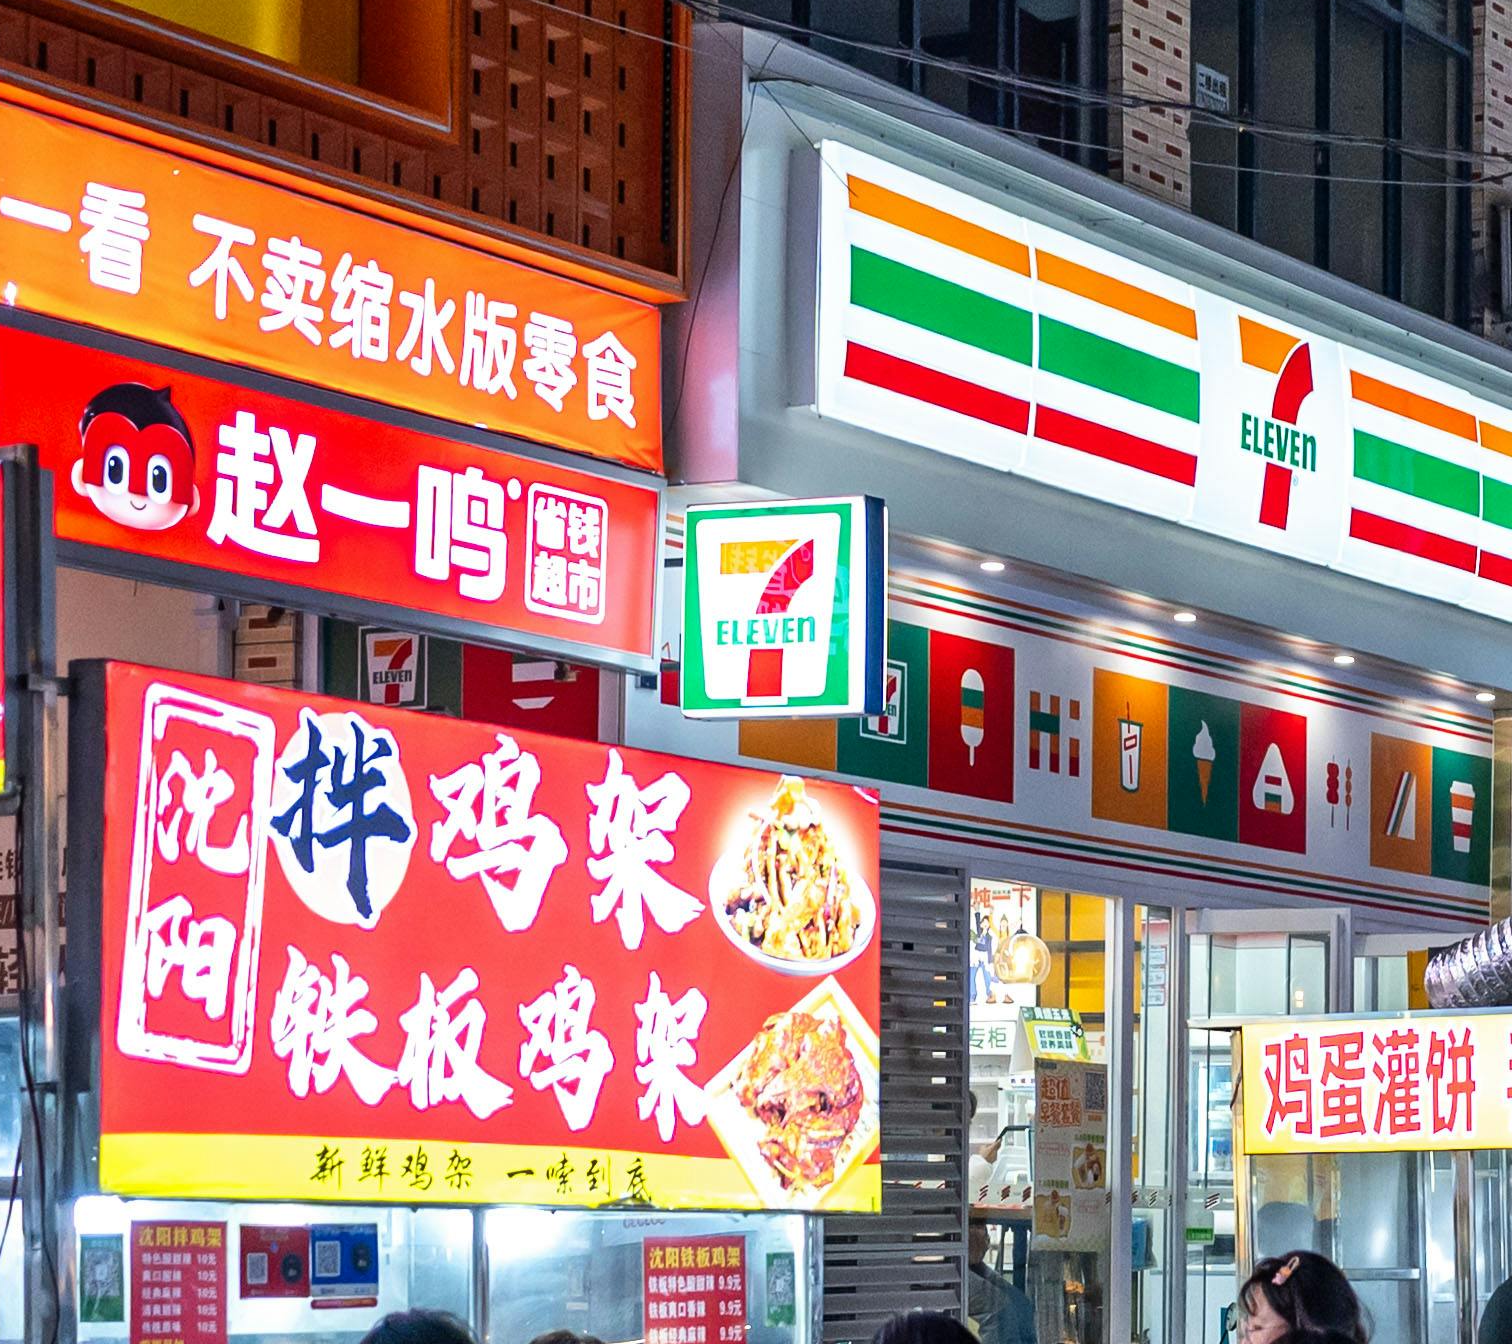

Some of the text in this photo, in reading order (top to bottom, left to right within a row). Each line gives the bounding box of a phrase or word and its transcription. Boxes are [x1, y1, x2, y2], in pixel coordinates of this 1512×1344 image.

[188, 213, 639, 431] 不卖缩水版零食
[205, 410, 508, 601] 赵一鸣
[533, 496, 601, 555] 省钱
[533, 550, 601, 616] 超市
[143, 746, 253, 1024] 沈阳
[268, 704, 706, 951] 拌鸡架
[267, 944, 711, 1145] 铁板鸡架
[1264, 1025, 1476, 1139] 鸡蛋灌饼
[310, 1144, 473, 1193] 新鲜鸡架
[649, 1246, 741, 1270] 沈阳铁板鸡架
